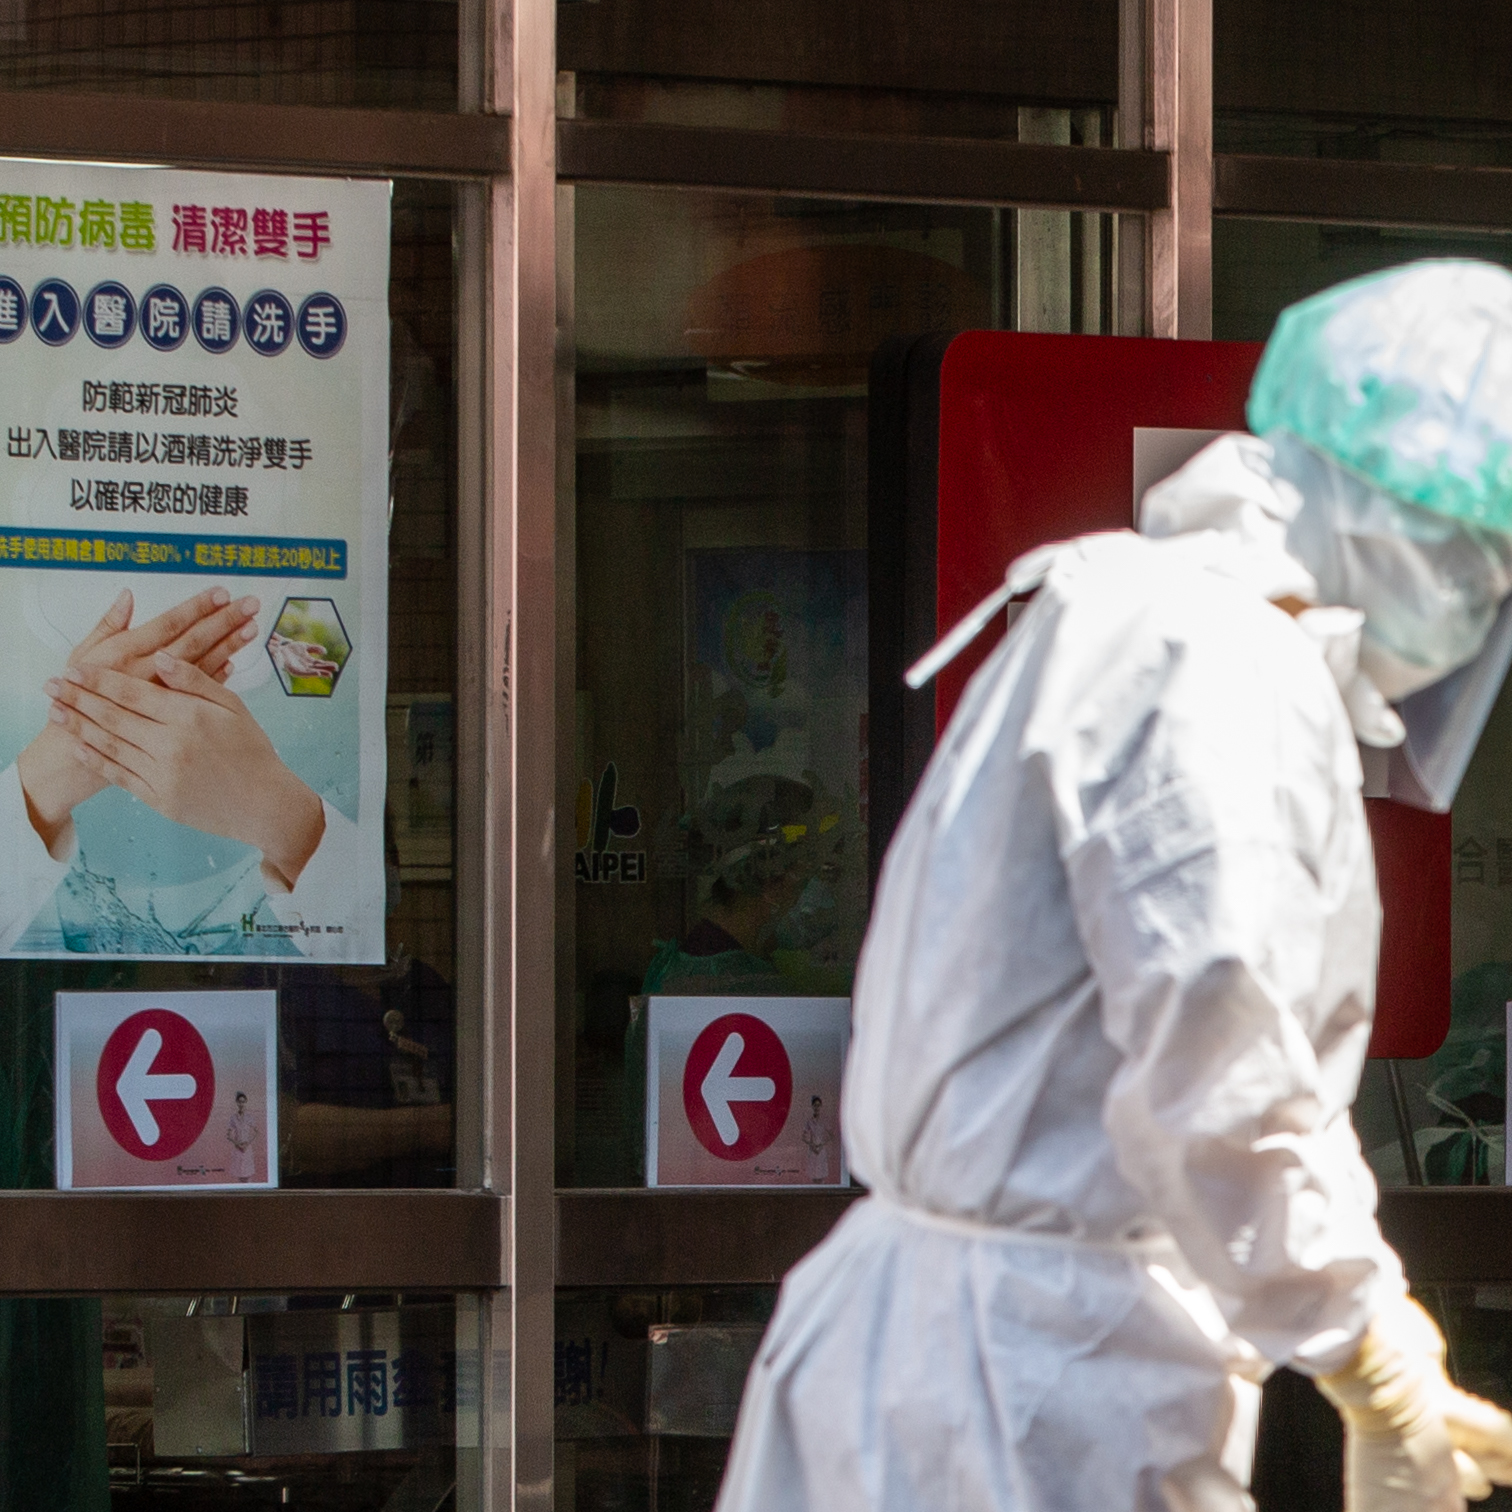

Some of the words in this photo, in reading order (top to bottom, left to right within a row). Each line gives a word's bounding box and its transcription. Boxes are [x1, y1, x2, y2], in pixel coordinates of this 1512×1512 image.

[0, 194, 156, 252] 預防病毒
[172, 204, 331, 259] 清潔雙手
[83, 380, 239, 418] 防範新冠肺炎
[8, 427, 313, 470] 出入醫院請以酒精洗淨雙手
[70, 479, 249, 516] 以確保您的健康
